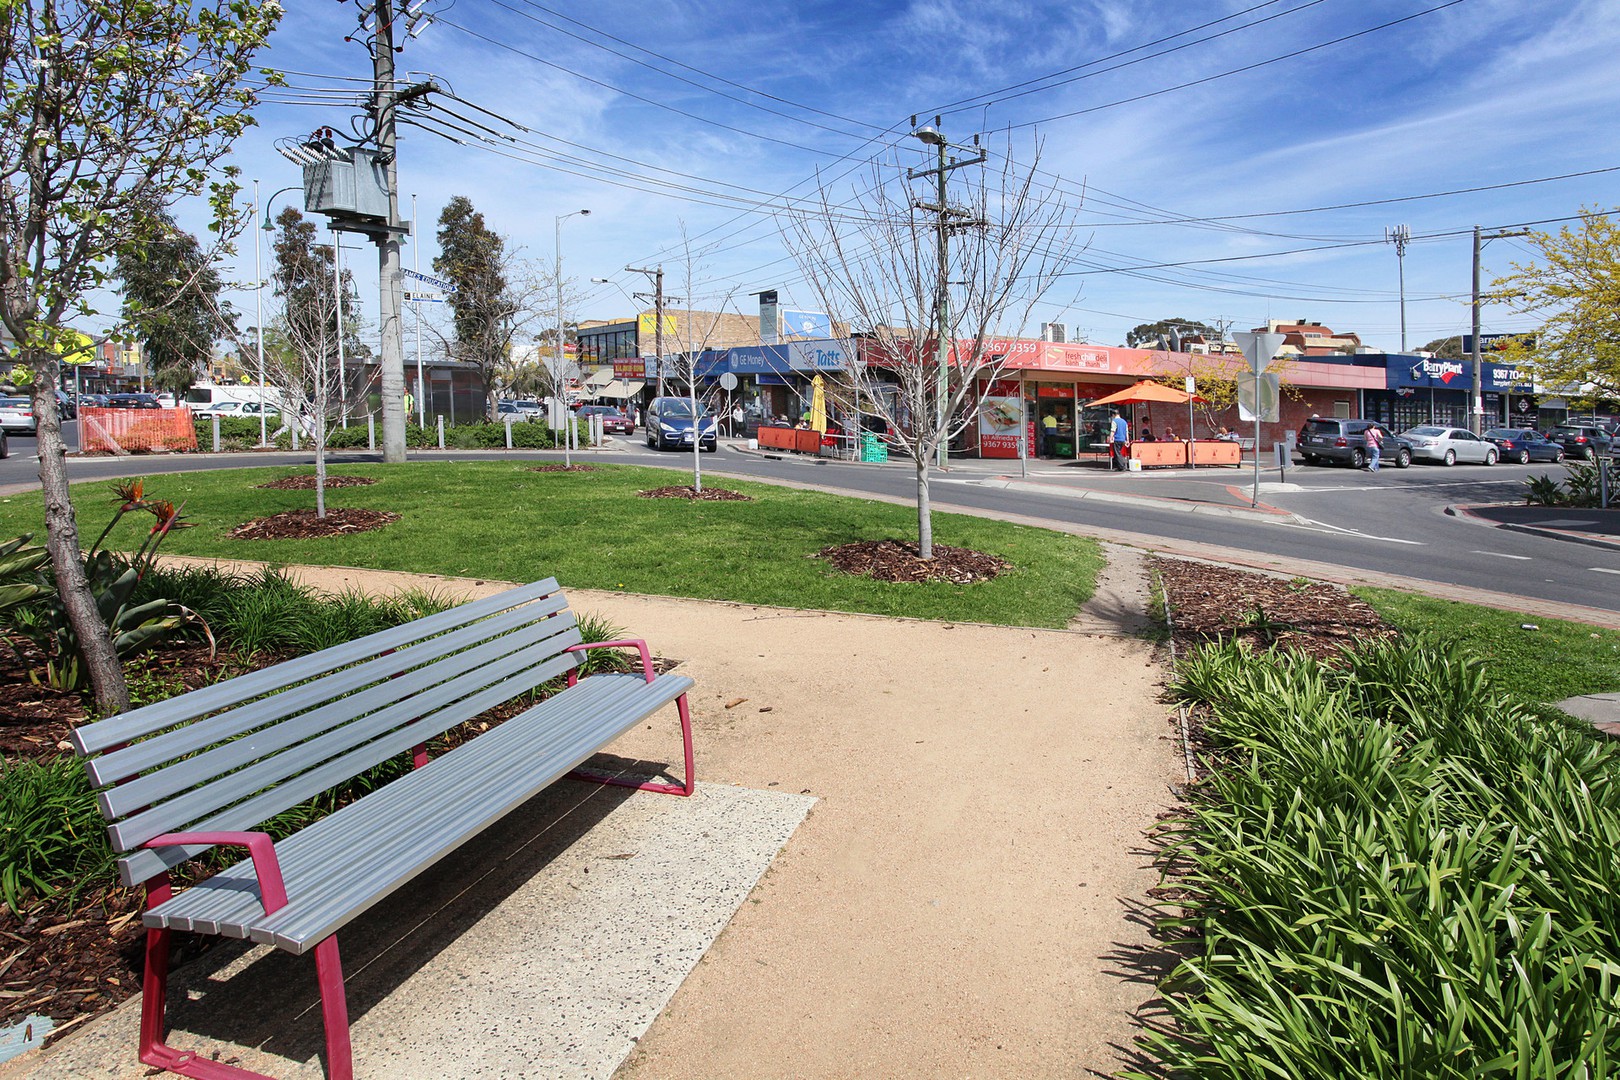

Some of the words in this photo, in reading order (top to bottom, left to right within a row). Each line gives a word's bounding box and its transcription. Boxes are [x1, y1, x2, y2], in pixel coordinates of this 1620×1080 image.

[423, 277, 452, 290] EDUCATION
[982, 342, 1007, 352] 9367
[1011, 343, 1037, 353] 9359
[739, 354, 747, 365] GE
[748, 355, 764, 367] Money
[816, 350, 841, 366] Tatts
